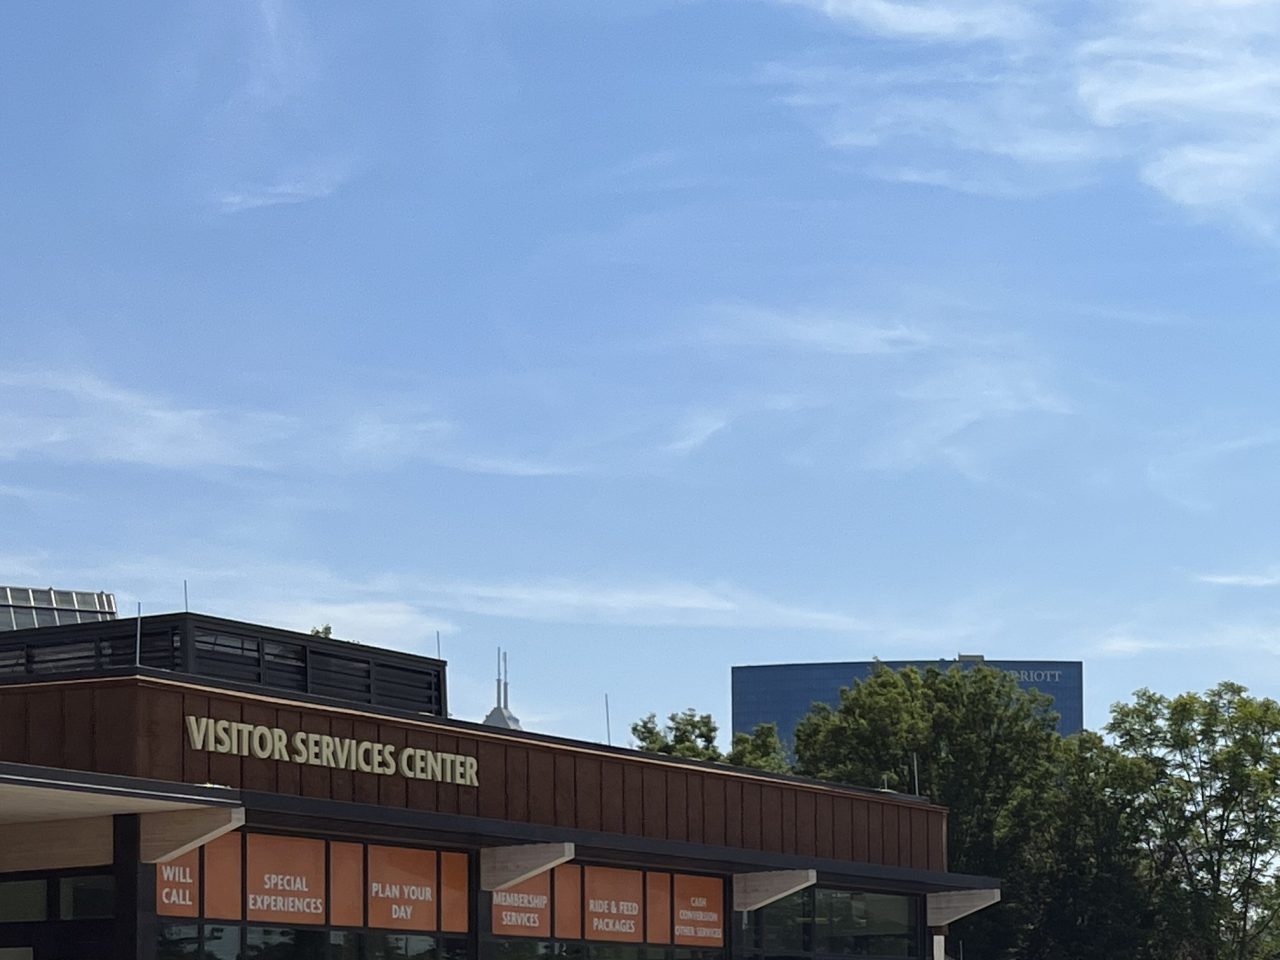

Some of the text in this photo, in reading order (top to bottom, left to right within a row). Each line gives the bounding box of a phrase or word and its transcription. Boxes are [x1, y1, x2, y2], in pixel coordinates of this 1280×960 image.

[185, 715, 480, 787] VISITOR SERVICES CENTER
[162, 865, 192, 883] WILL
[264, 874, 309, 892] SPECIAL
[162, 888, 192, 905] CALL
[371, 882, 433, 902] PLAN YOUR
[492, 891, 548, 909] MEMBERSHIP
[248, 894, 323, 914] EXPERIENCES
[391, 904, 413, 920] DAY
[589, 900, 639, 916] RIDE & FEED
[502, 911, 540, 928] SERVICES
[592, 918, 636, 933] PACKAGES
